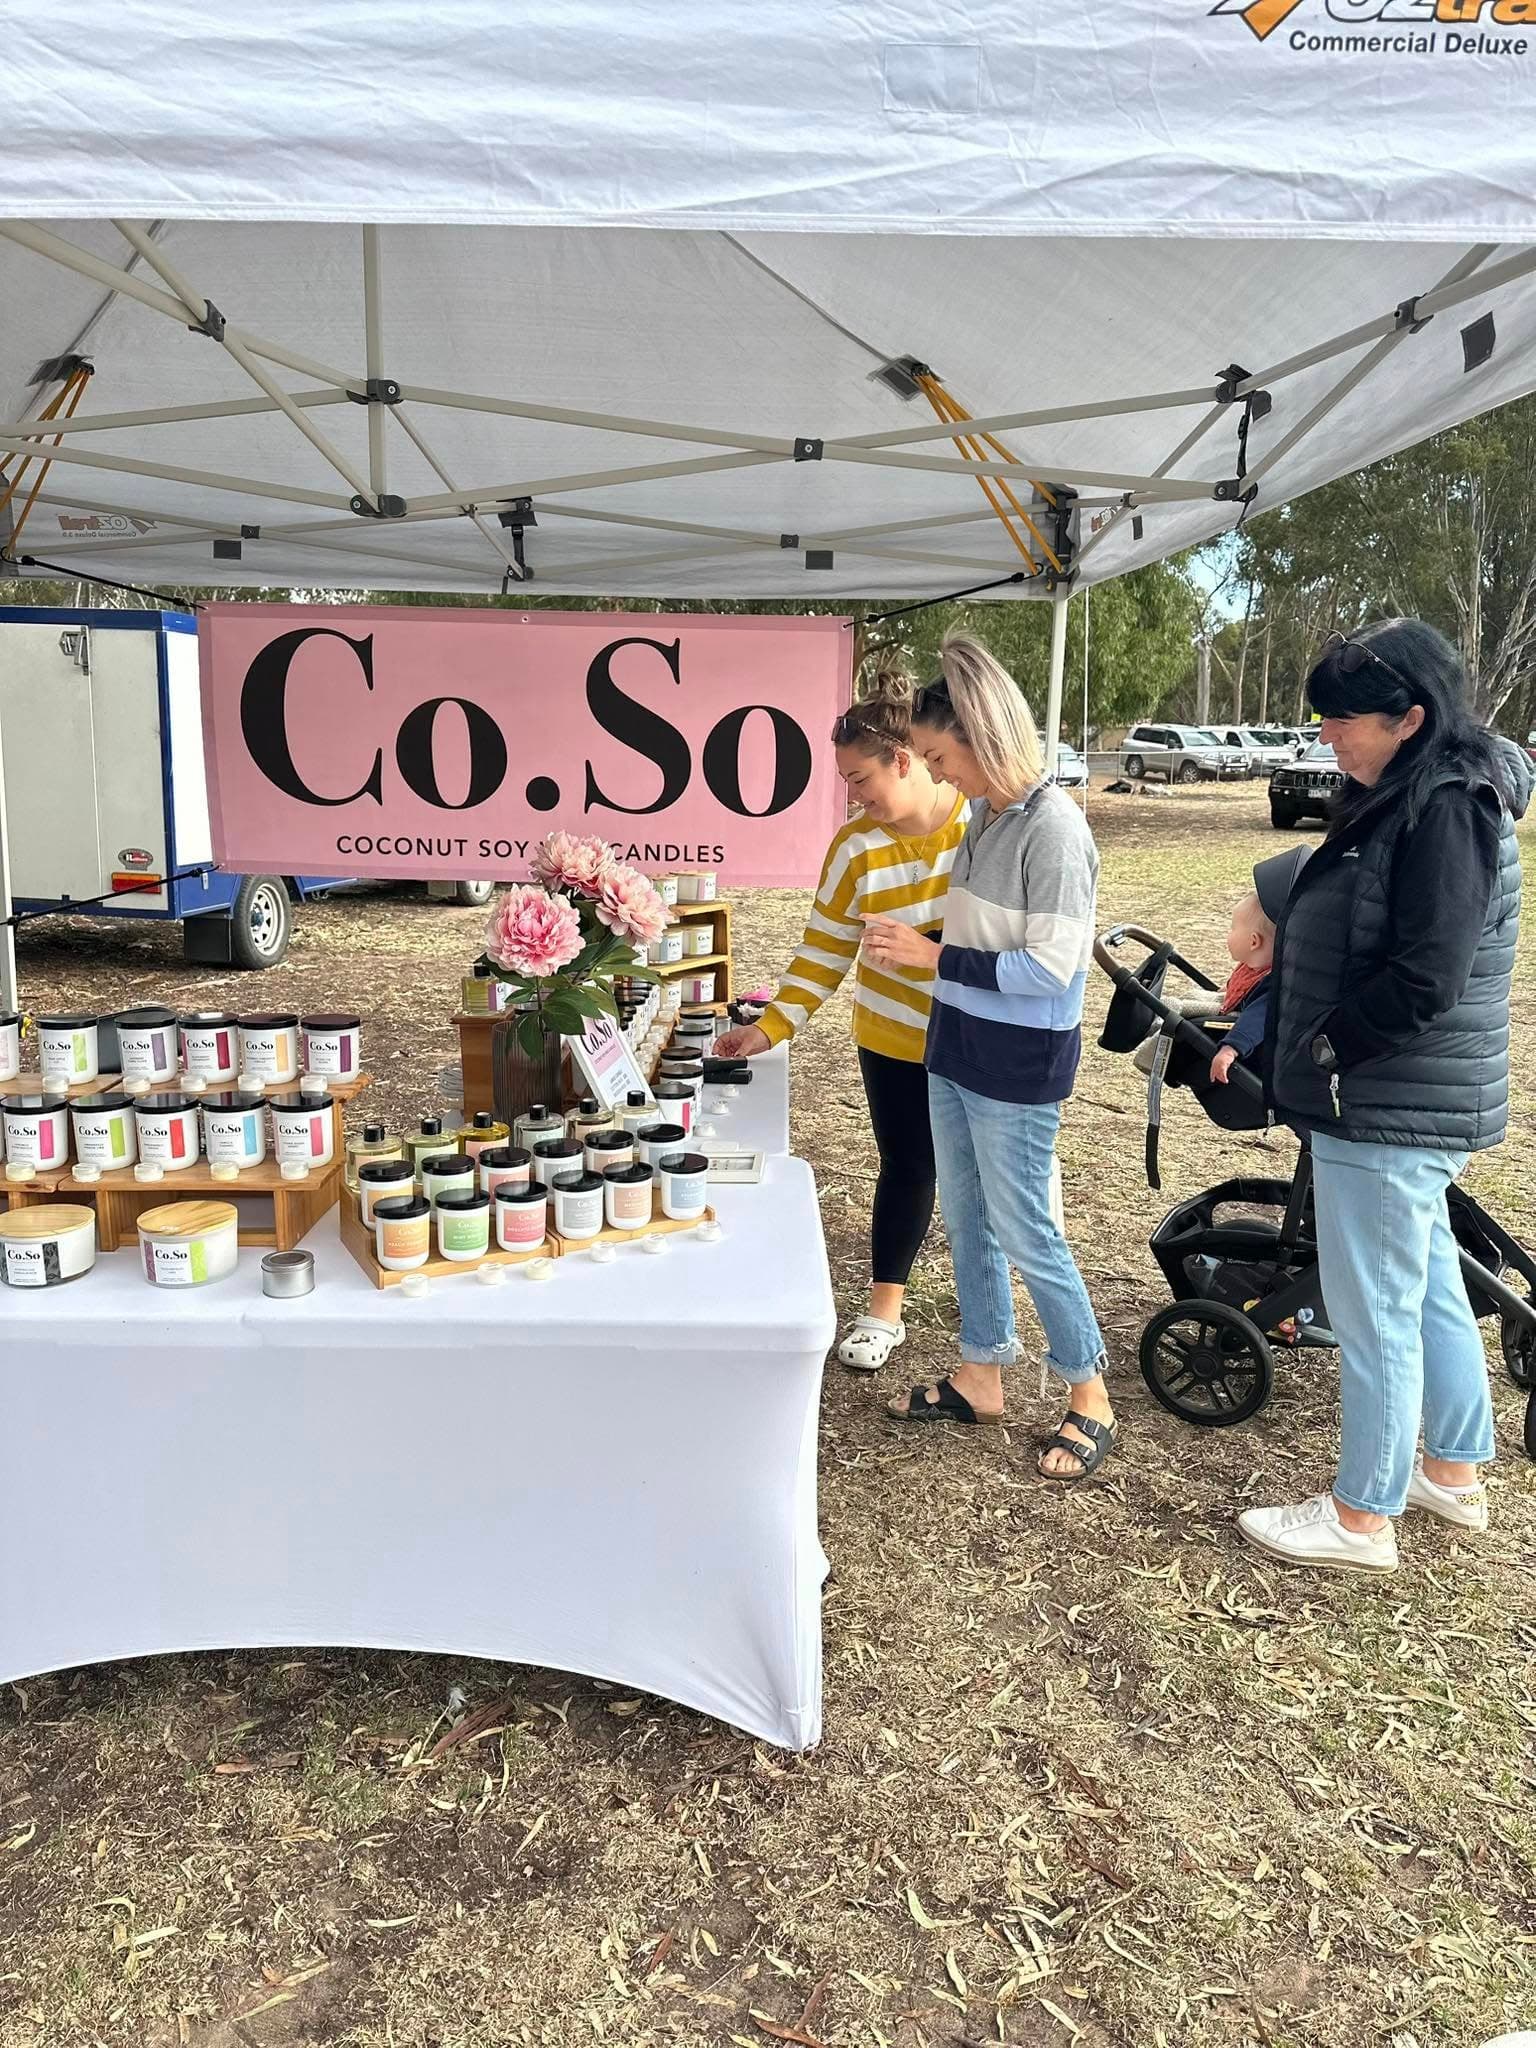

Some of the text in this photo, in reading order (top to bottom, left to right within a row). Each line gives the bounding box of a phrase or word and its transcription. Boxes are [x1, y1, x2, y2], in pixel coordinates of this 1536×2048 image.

[1289, 30, 1528, 55] Commercial Deluxe
[240, 627, 813, 818] Co.So
[336, 835, 725, 863] COCONUT SOY CANDLES
[43, 1040, 71, 1050] Co.So
[122, 1041, 150, 1050] Co.So
[186, 1038, 214, 1049] Co.So
[246, 1040, 273, 1050] Co.So
[310, 1041, 338, 1051] Co.So
[8, 1125, 37, 1136] Co.So
[78, 1125, 108, 1136] Co.So
[140, 1125, 168, 1136] Co.So
[211, 1123, 241, 1134] Co.So
[279, 1124, 308, 1135] Co.So
[7, 1250, 41, 1260] Co.So
[155, 1250, 188, 1260] Co.So
